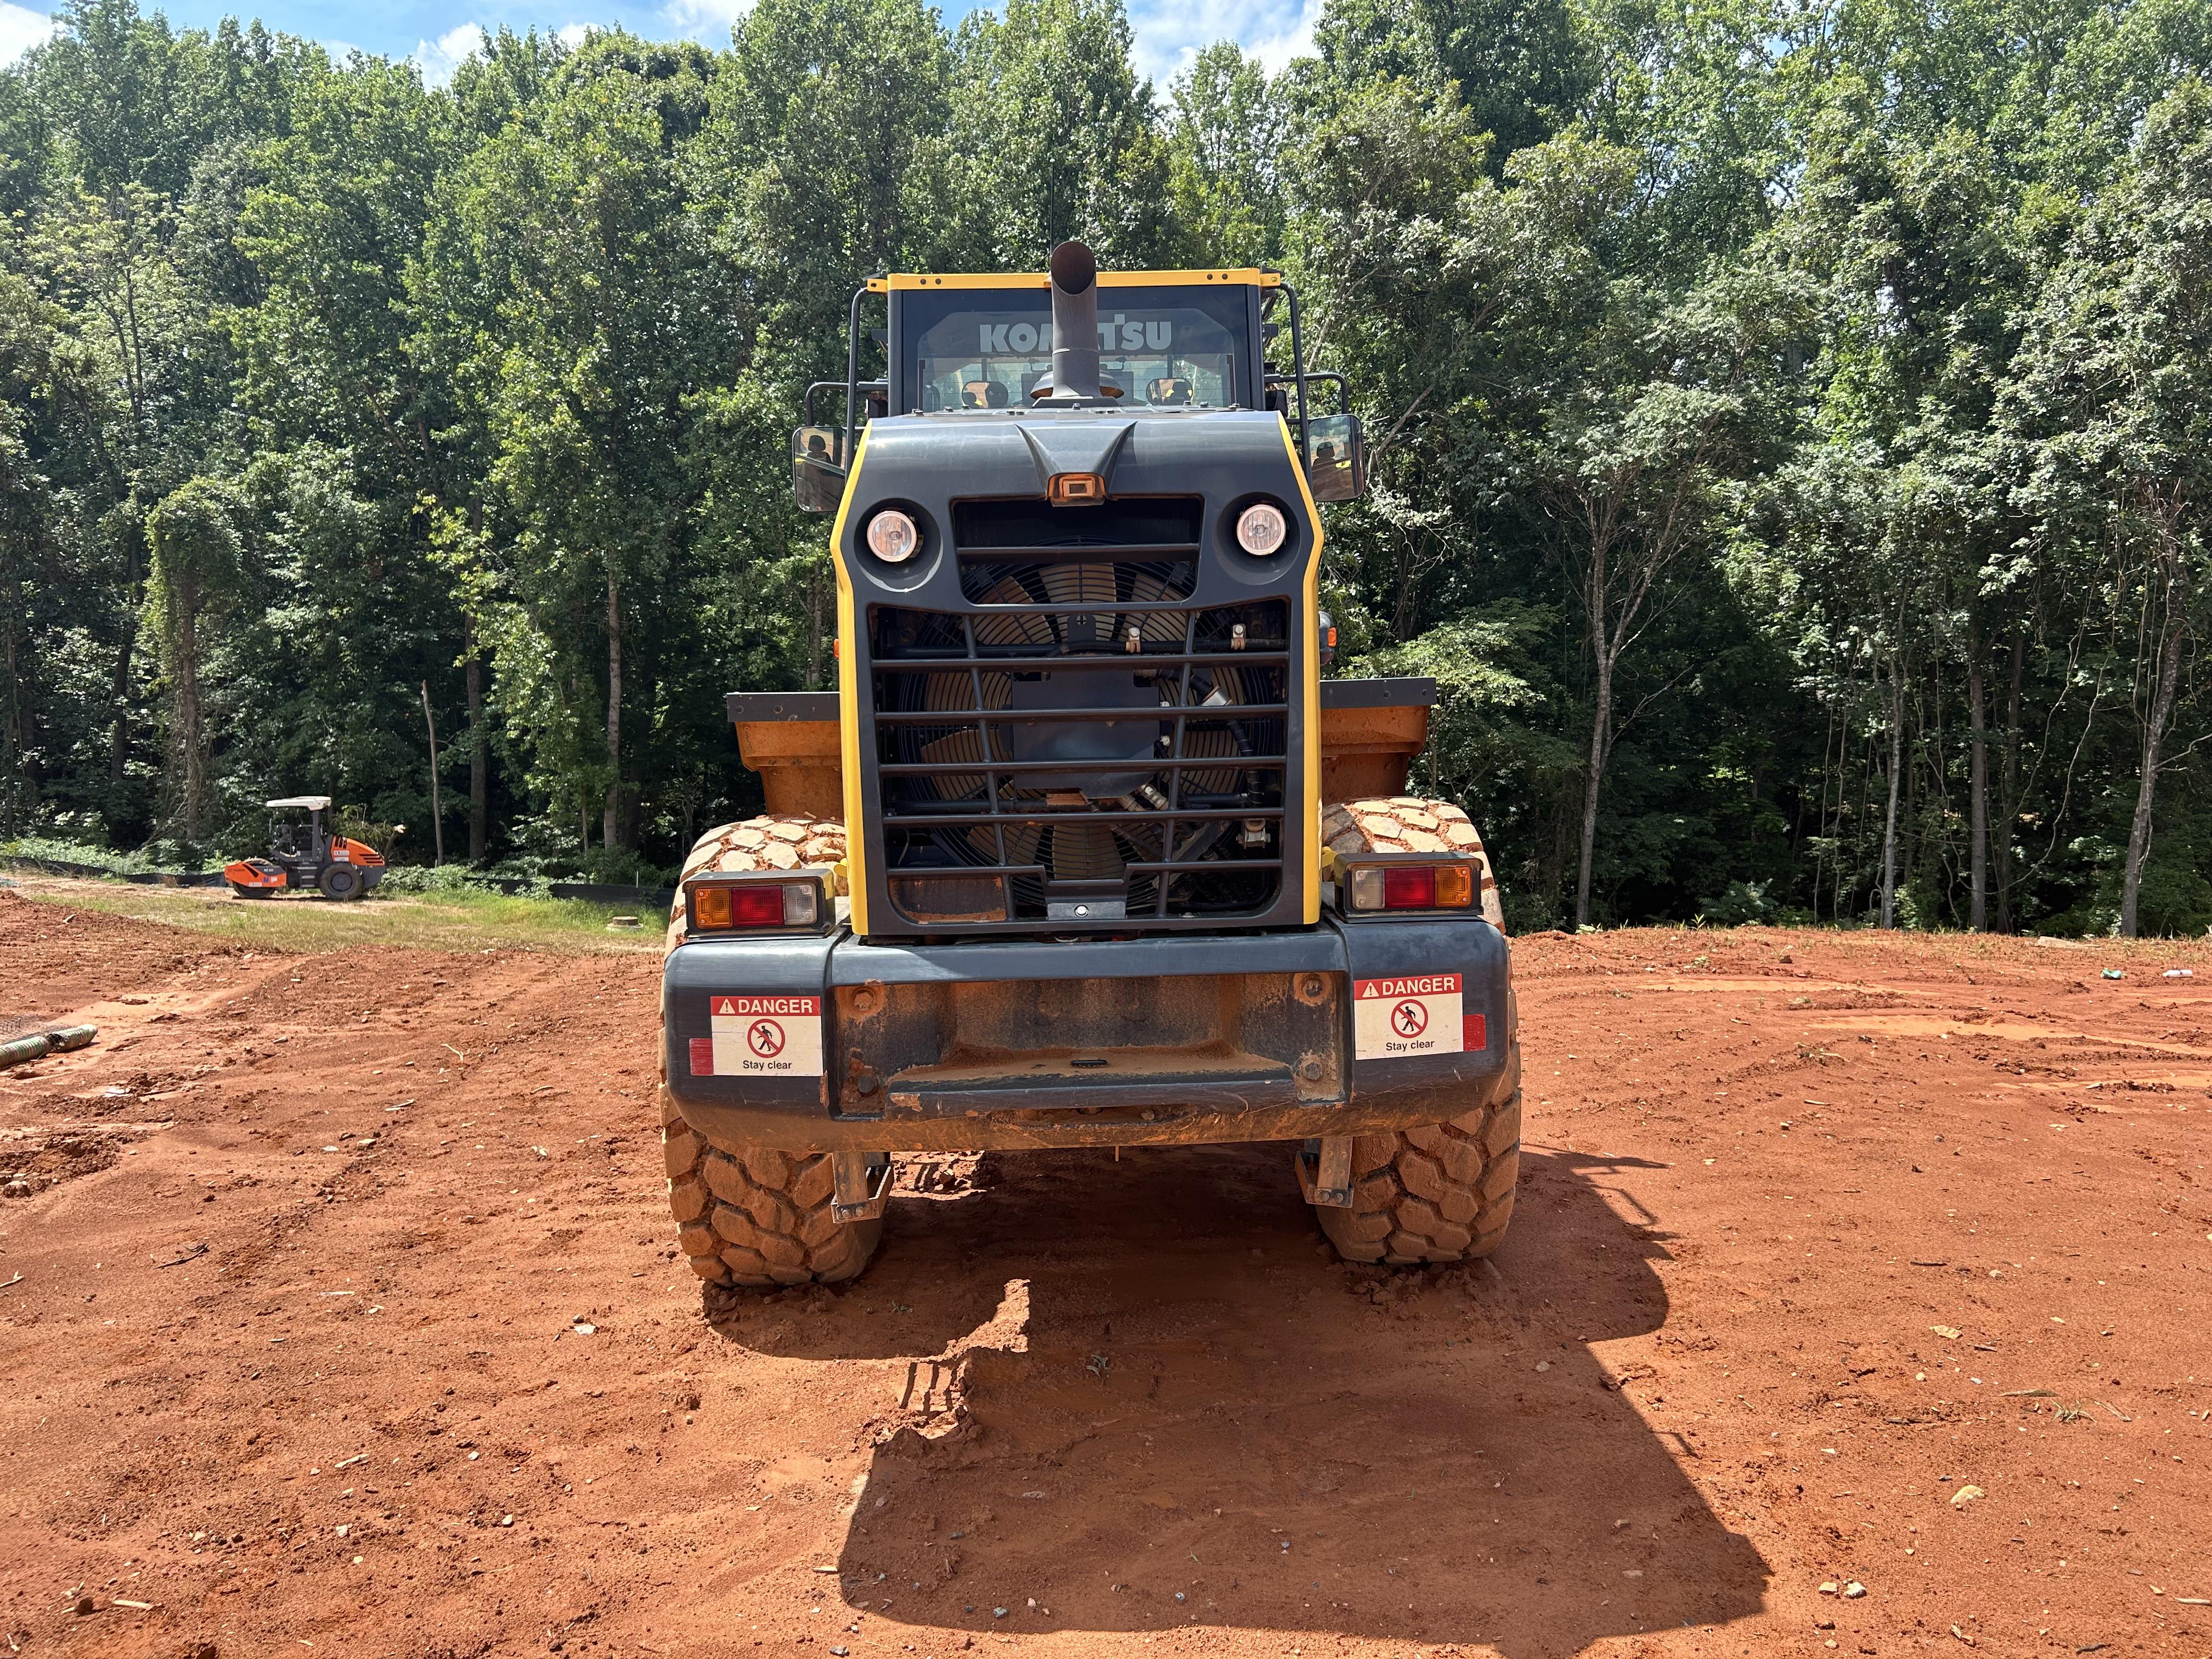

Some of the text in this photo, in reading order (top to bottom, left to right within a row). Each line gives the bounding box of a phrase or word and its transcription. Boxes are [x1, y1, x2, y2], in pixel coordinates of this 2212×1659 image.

[979, 314, 1172, 353] KOTSU
[1383, 977, 1454, 995] DANGER
[738, 999, 812, 1013] DANGER
[1386, 1040, 1434, 1052] Stay clear
[743, 1060, 792, 1071] Stay clear
